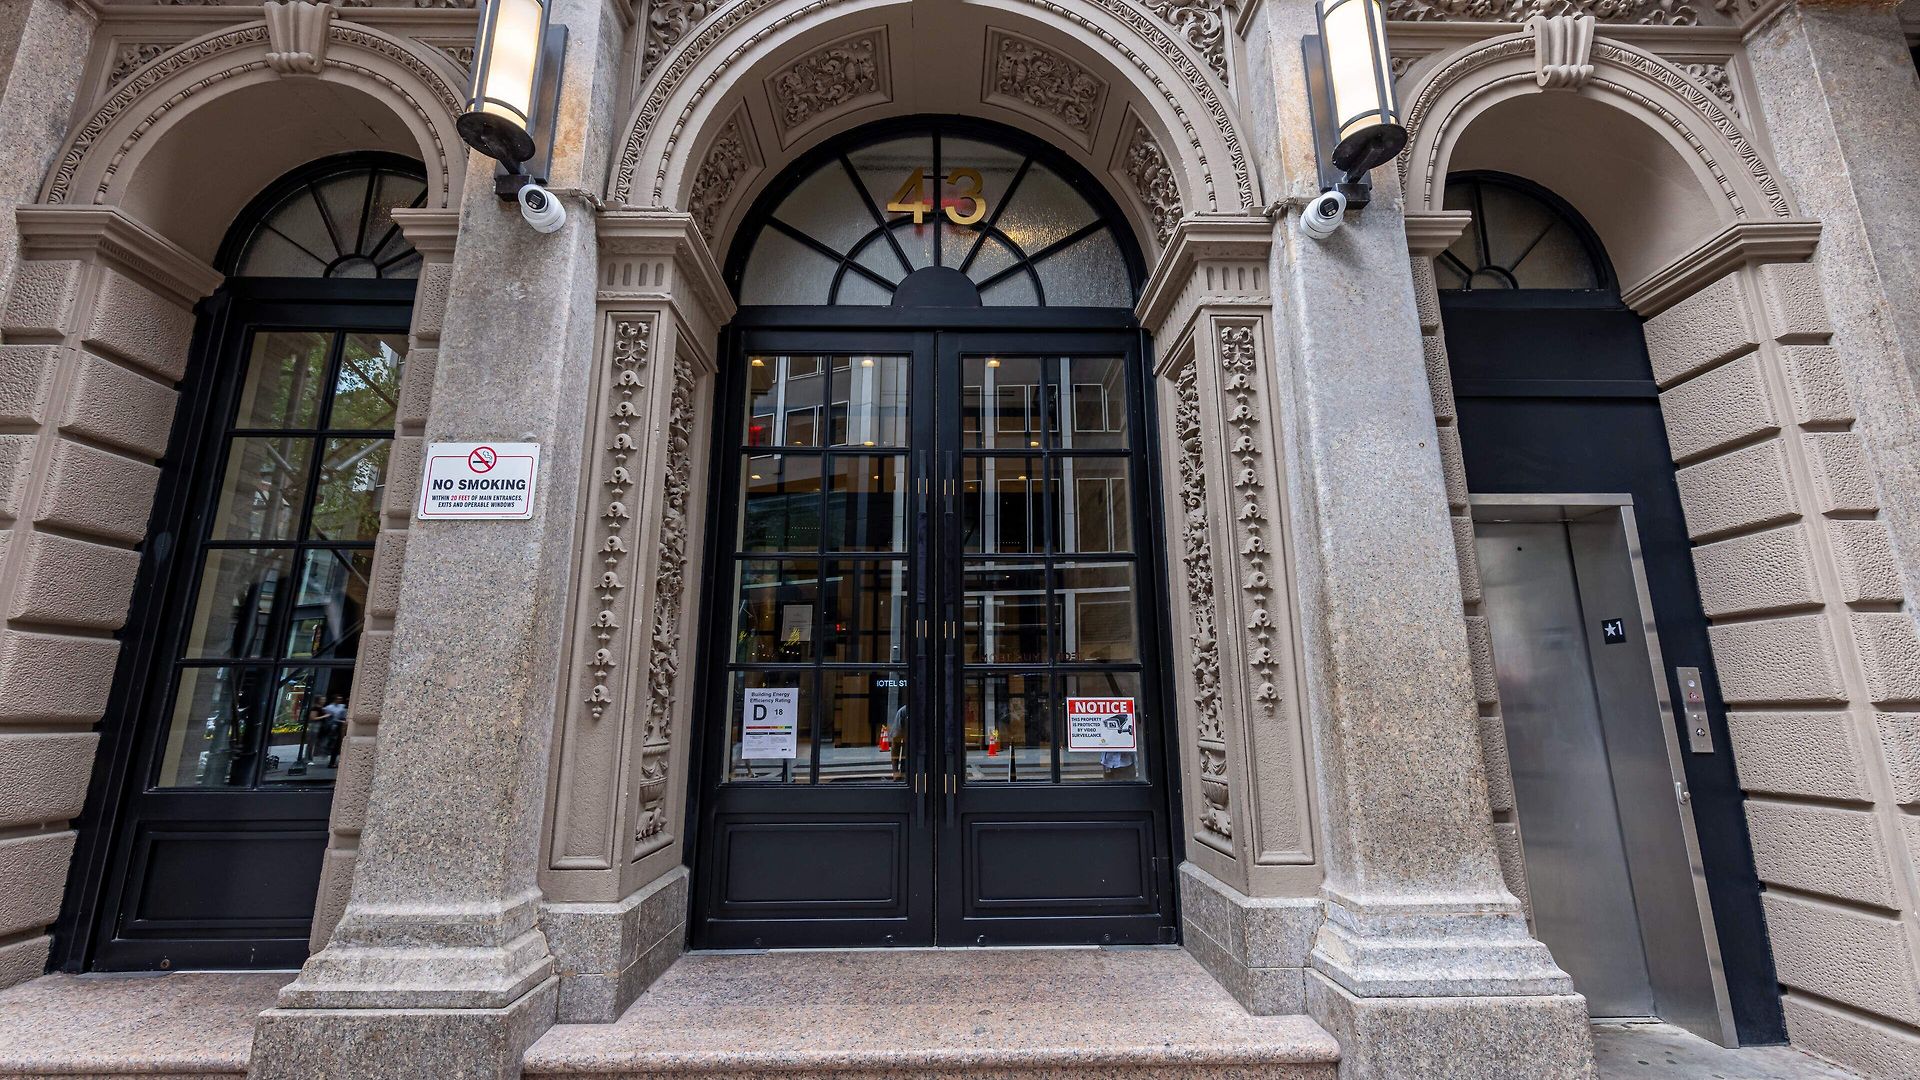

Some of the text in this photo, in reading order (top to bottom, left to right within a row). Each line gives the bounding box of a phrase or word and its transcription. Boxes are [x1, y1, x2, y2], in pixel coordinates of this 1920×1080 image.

[887, 166, 986, 225] 43
[433, 480, 526, 490] NO SMOKING
[1616, 621, 1623, 635] 1
[754, 704, 767, 720] D
[1075, 701, 1127, 713] NOTICE
